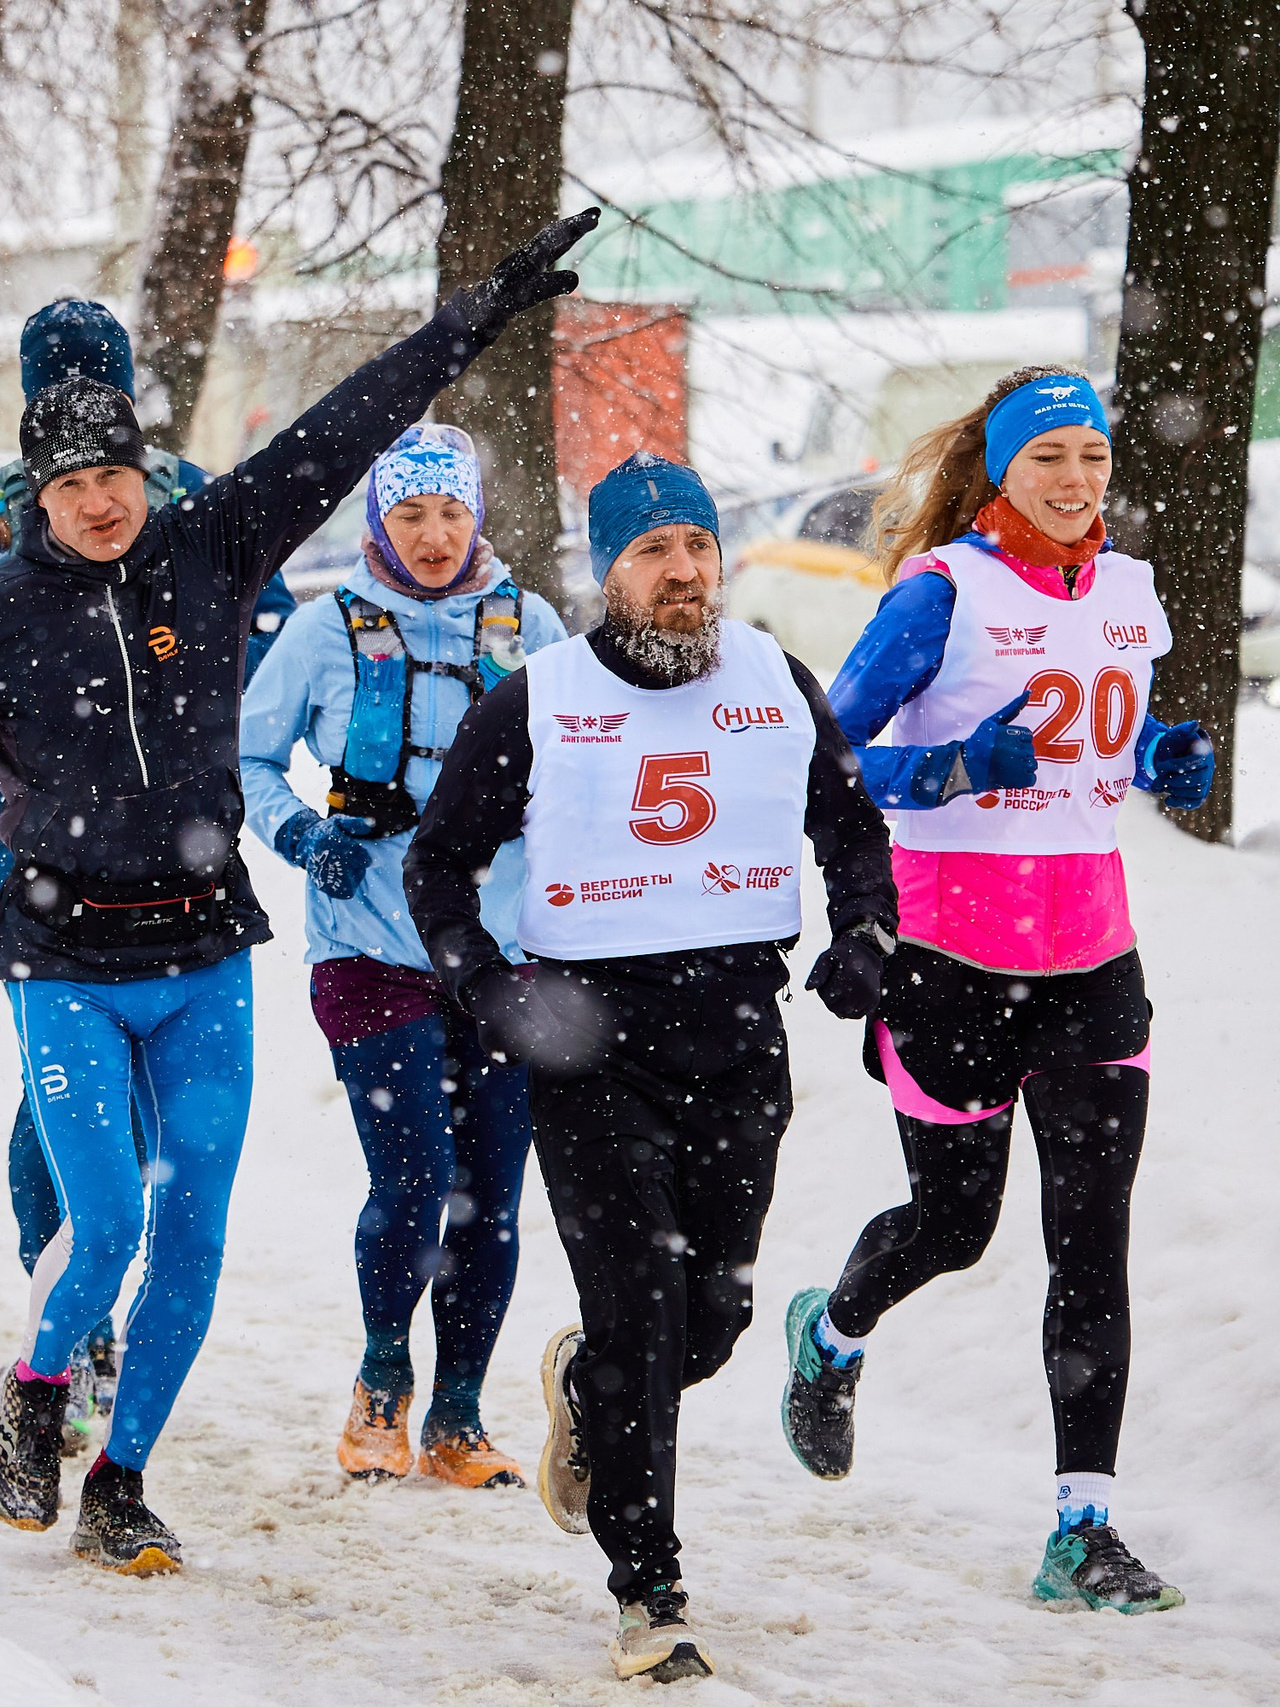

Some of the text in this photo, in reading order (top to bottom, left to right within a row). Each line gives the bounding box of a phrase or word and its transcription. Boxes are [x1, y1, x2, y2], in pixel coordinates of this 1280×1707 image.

[1034, 405, 1052, 415] MAD
[1068, 402, 1091, 410] ULTRA
[1109, 625, 1147, 643] НЦВ
[995, 647, 1046, 657] ВИНТОКРЫЛЫЕ
[723, 706, 784, 726] НЦВ
[1024, 666, 1138, 764] 20
[560, 734, 623, 743] ВИНТОКРЫЛЫЕ
[629, 751, 717, 846] 5
[747, 865, 795, 877] ППОС
[580, 873, 673, 892] ВЕРТОЛЕТЫ
[746, 877, 780, 890] НЦВ
[581, 889, 642, 903] РОССИИ
[652, 1584, 667, 1592] ANTA
